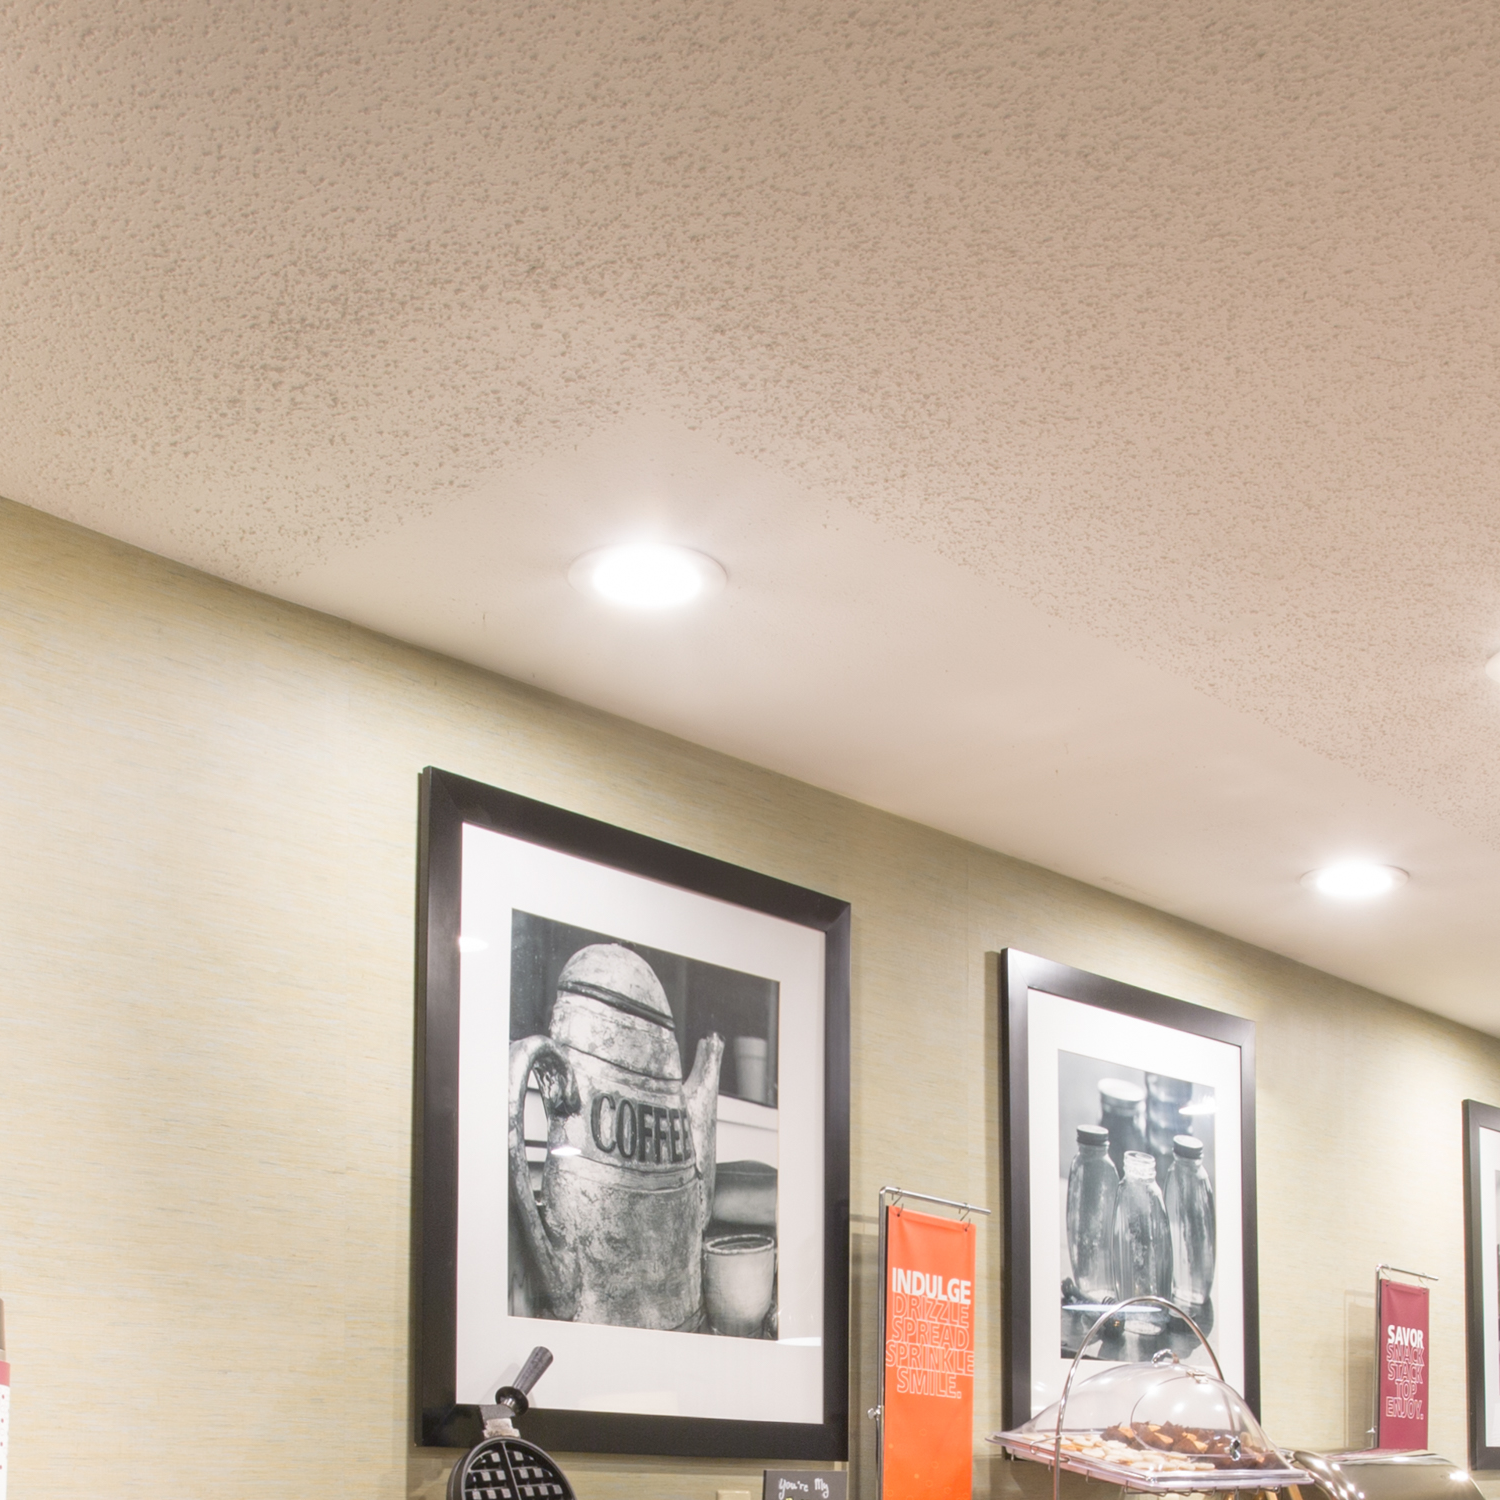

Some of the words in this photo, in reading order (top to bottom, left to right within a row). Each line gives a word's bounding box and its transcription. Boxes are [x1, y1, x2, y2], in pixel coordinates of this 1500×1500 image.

[591, 1094, 691, 1163] COFFEE
[892, 1267, 971, 1304] INDULGE
[893, 1292, 969, 1328] DRIZZLE
[892, 1316, 970, 1351] SPREAD
[1387, 1324, 1424, 1348] SAVOR
[885, 1340, 974, 1376] SPRINKLE
[1386, 1342, 1425, 1366] SNACK
[896, 1365, 962, 1399] SMILE.
[1387, 1360, 1424, 1384] STACK
[1394, 1379, 1417, 1400] TOP
[1385, 1396, 1424, 1420] ENJOY.
